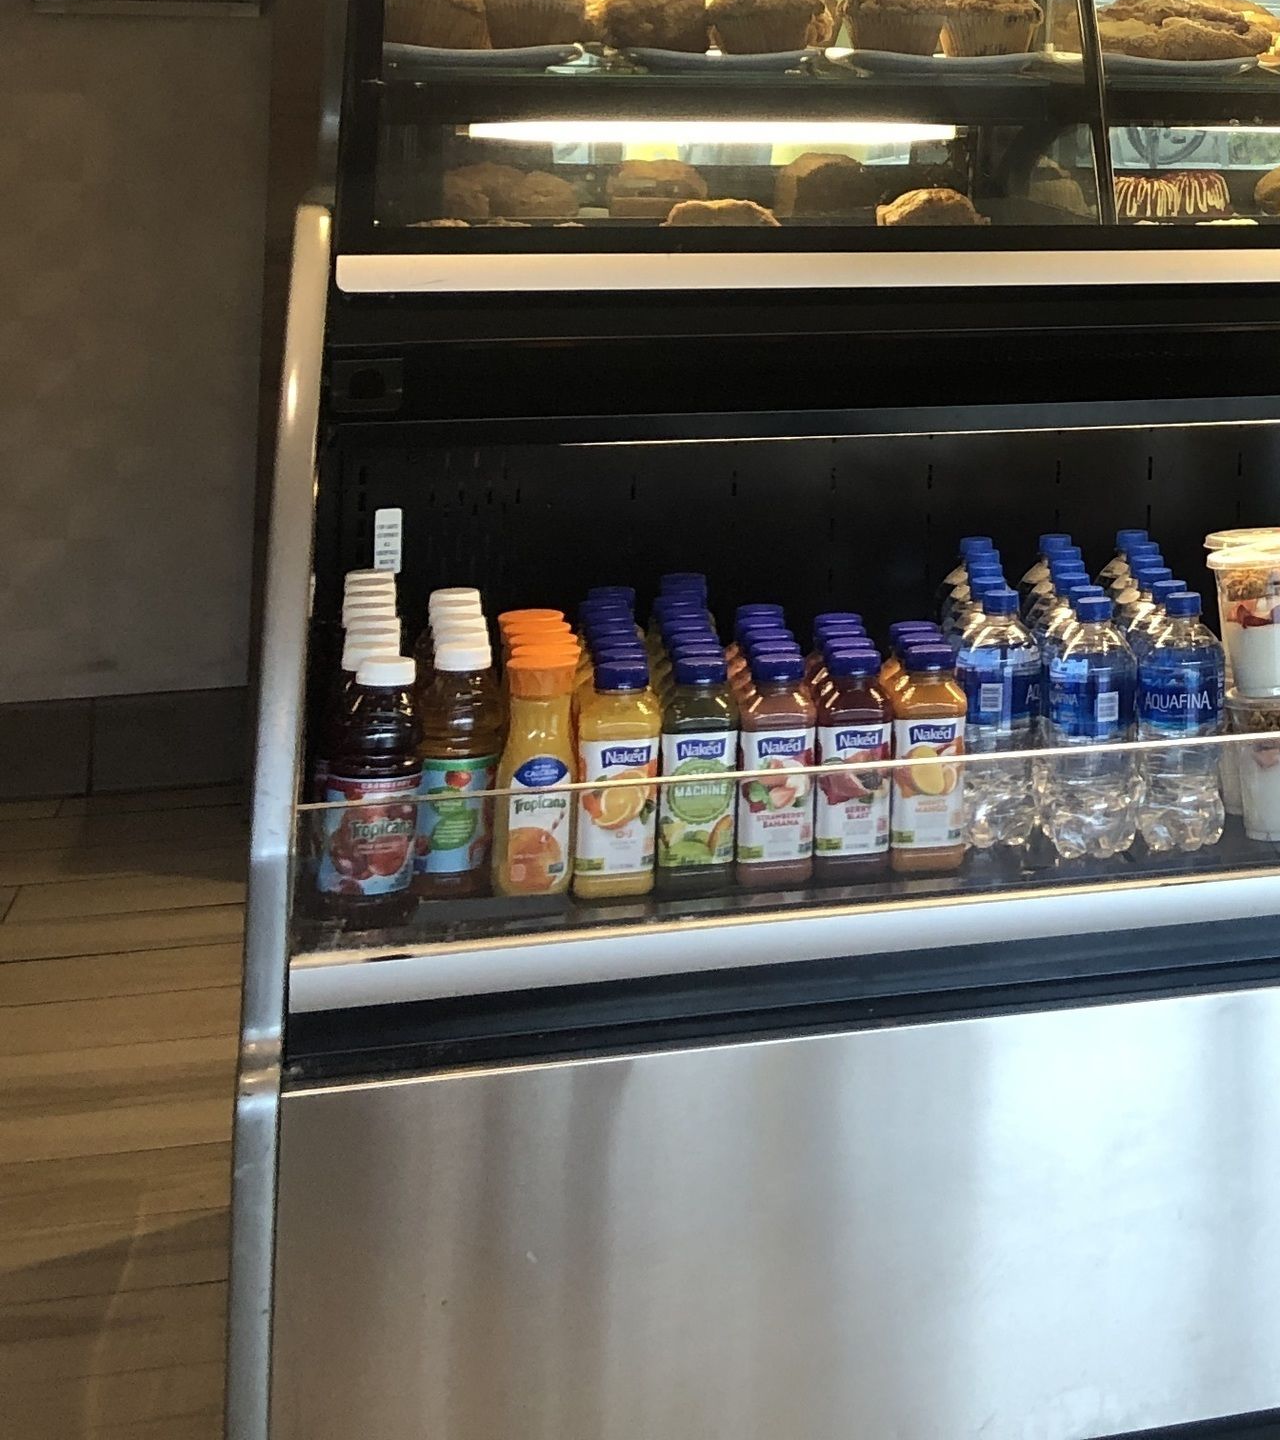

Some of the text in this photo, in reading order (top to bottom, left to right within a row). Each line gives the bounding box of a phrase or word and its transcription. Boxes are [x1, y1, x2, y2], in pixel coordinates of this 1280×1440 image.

[1145, 690, 1213, 712] AQUAFINA
[839, 732, 880, 748] Naked
[914, 725, 952, 741] Naked
[680, 741, 722, 757] Naked
[761, 738, 801, 756] Naked
[605, 748, 647, 764] Naked
[674, 784, 728, 798] MACHINE
[513, 797, 567, 814] Tropicana
[351, 818, 414, 842] Tropicana
